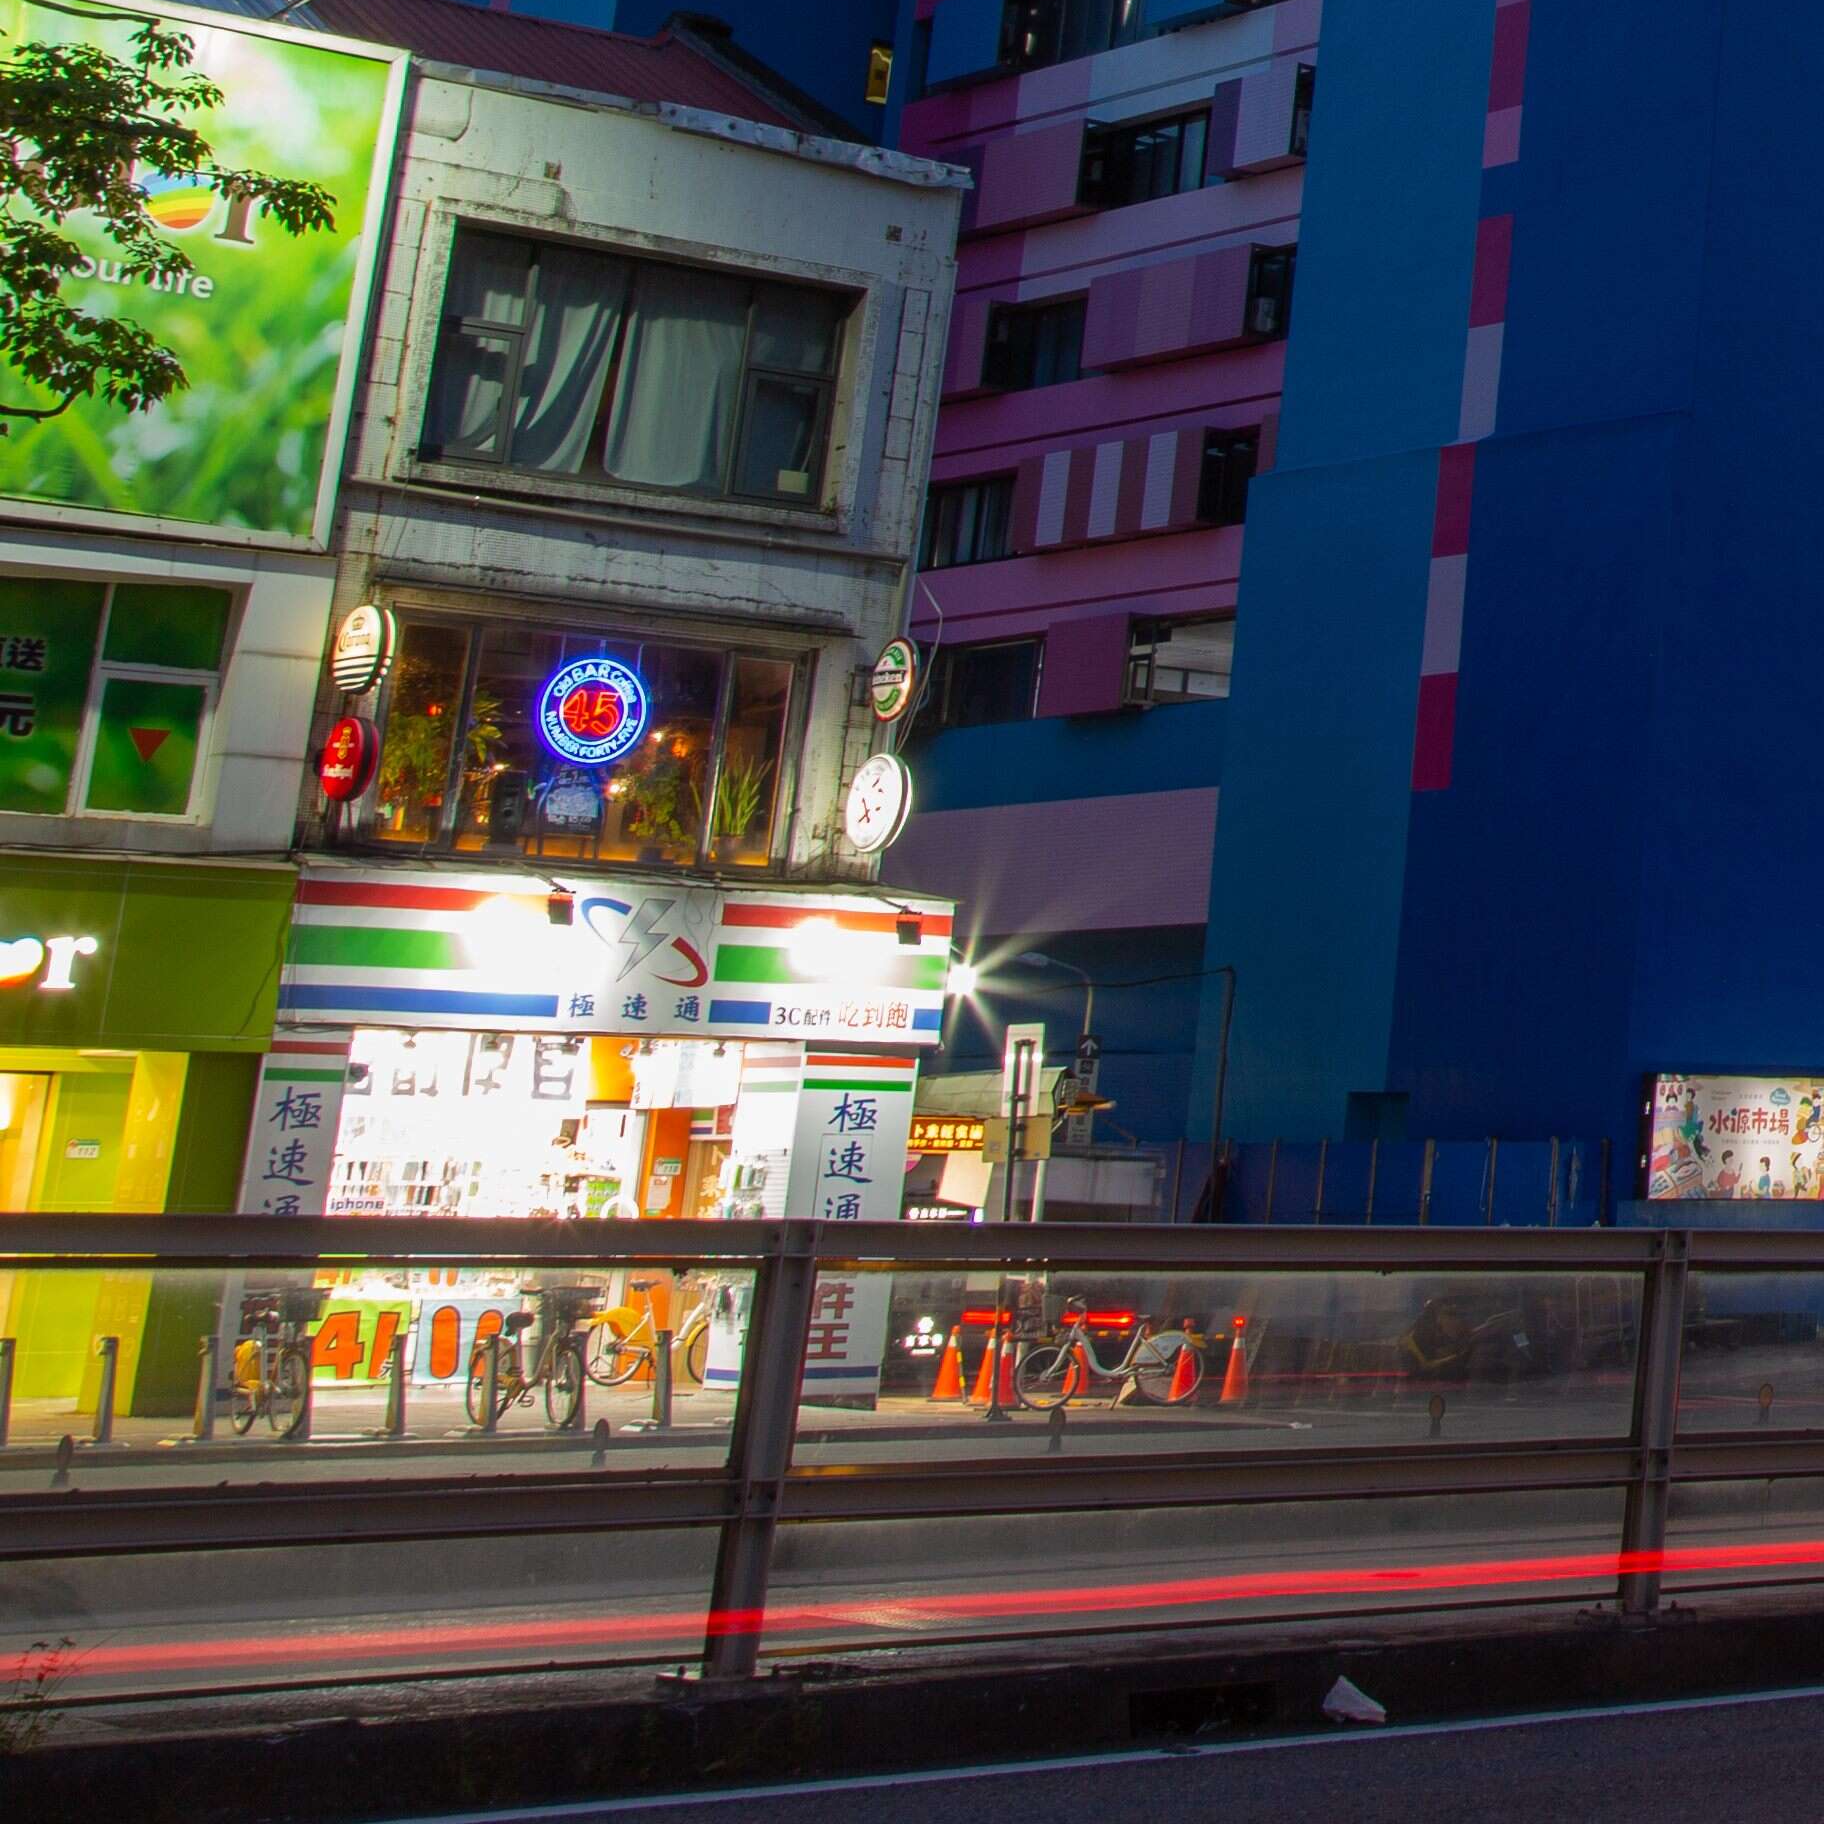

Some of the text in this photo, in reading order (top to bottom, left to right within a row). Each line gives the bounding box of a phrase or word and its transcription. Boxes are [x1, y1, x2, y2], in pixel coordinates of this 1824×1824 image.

[0, 636, 46, 671] 送
[553, 672, 574, 698] Old
[571, 663, 611, 681] BAR
[563, 688, 620, 737] 45
[545, 710, 581, 756] NUMBER
[569, 991, 701, 1023] 極速通
[838, 1001, 911, 1030] 吃到飽
[1708, 1107, 1791, 1136] 水源市場
[330, 1197, 384, 1212] iphone
